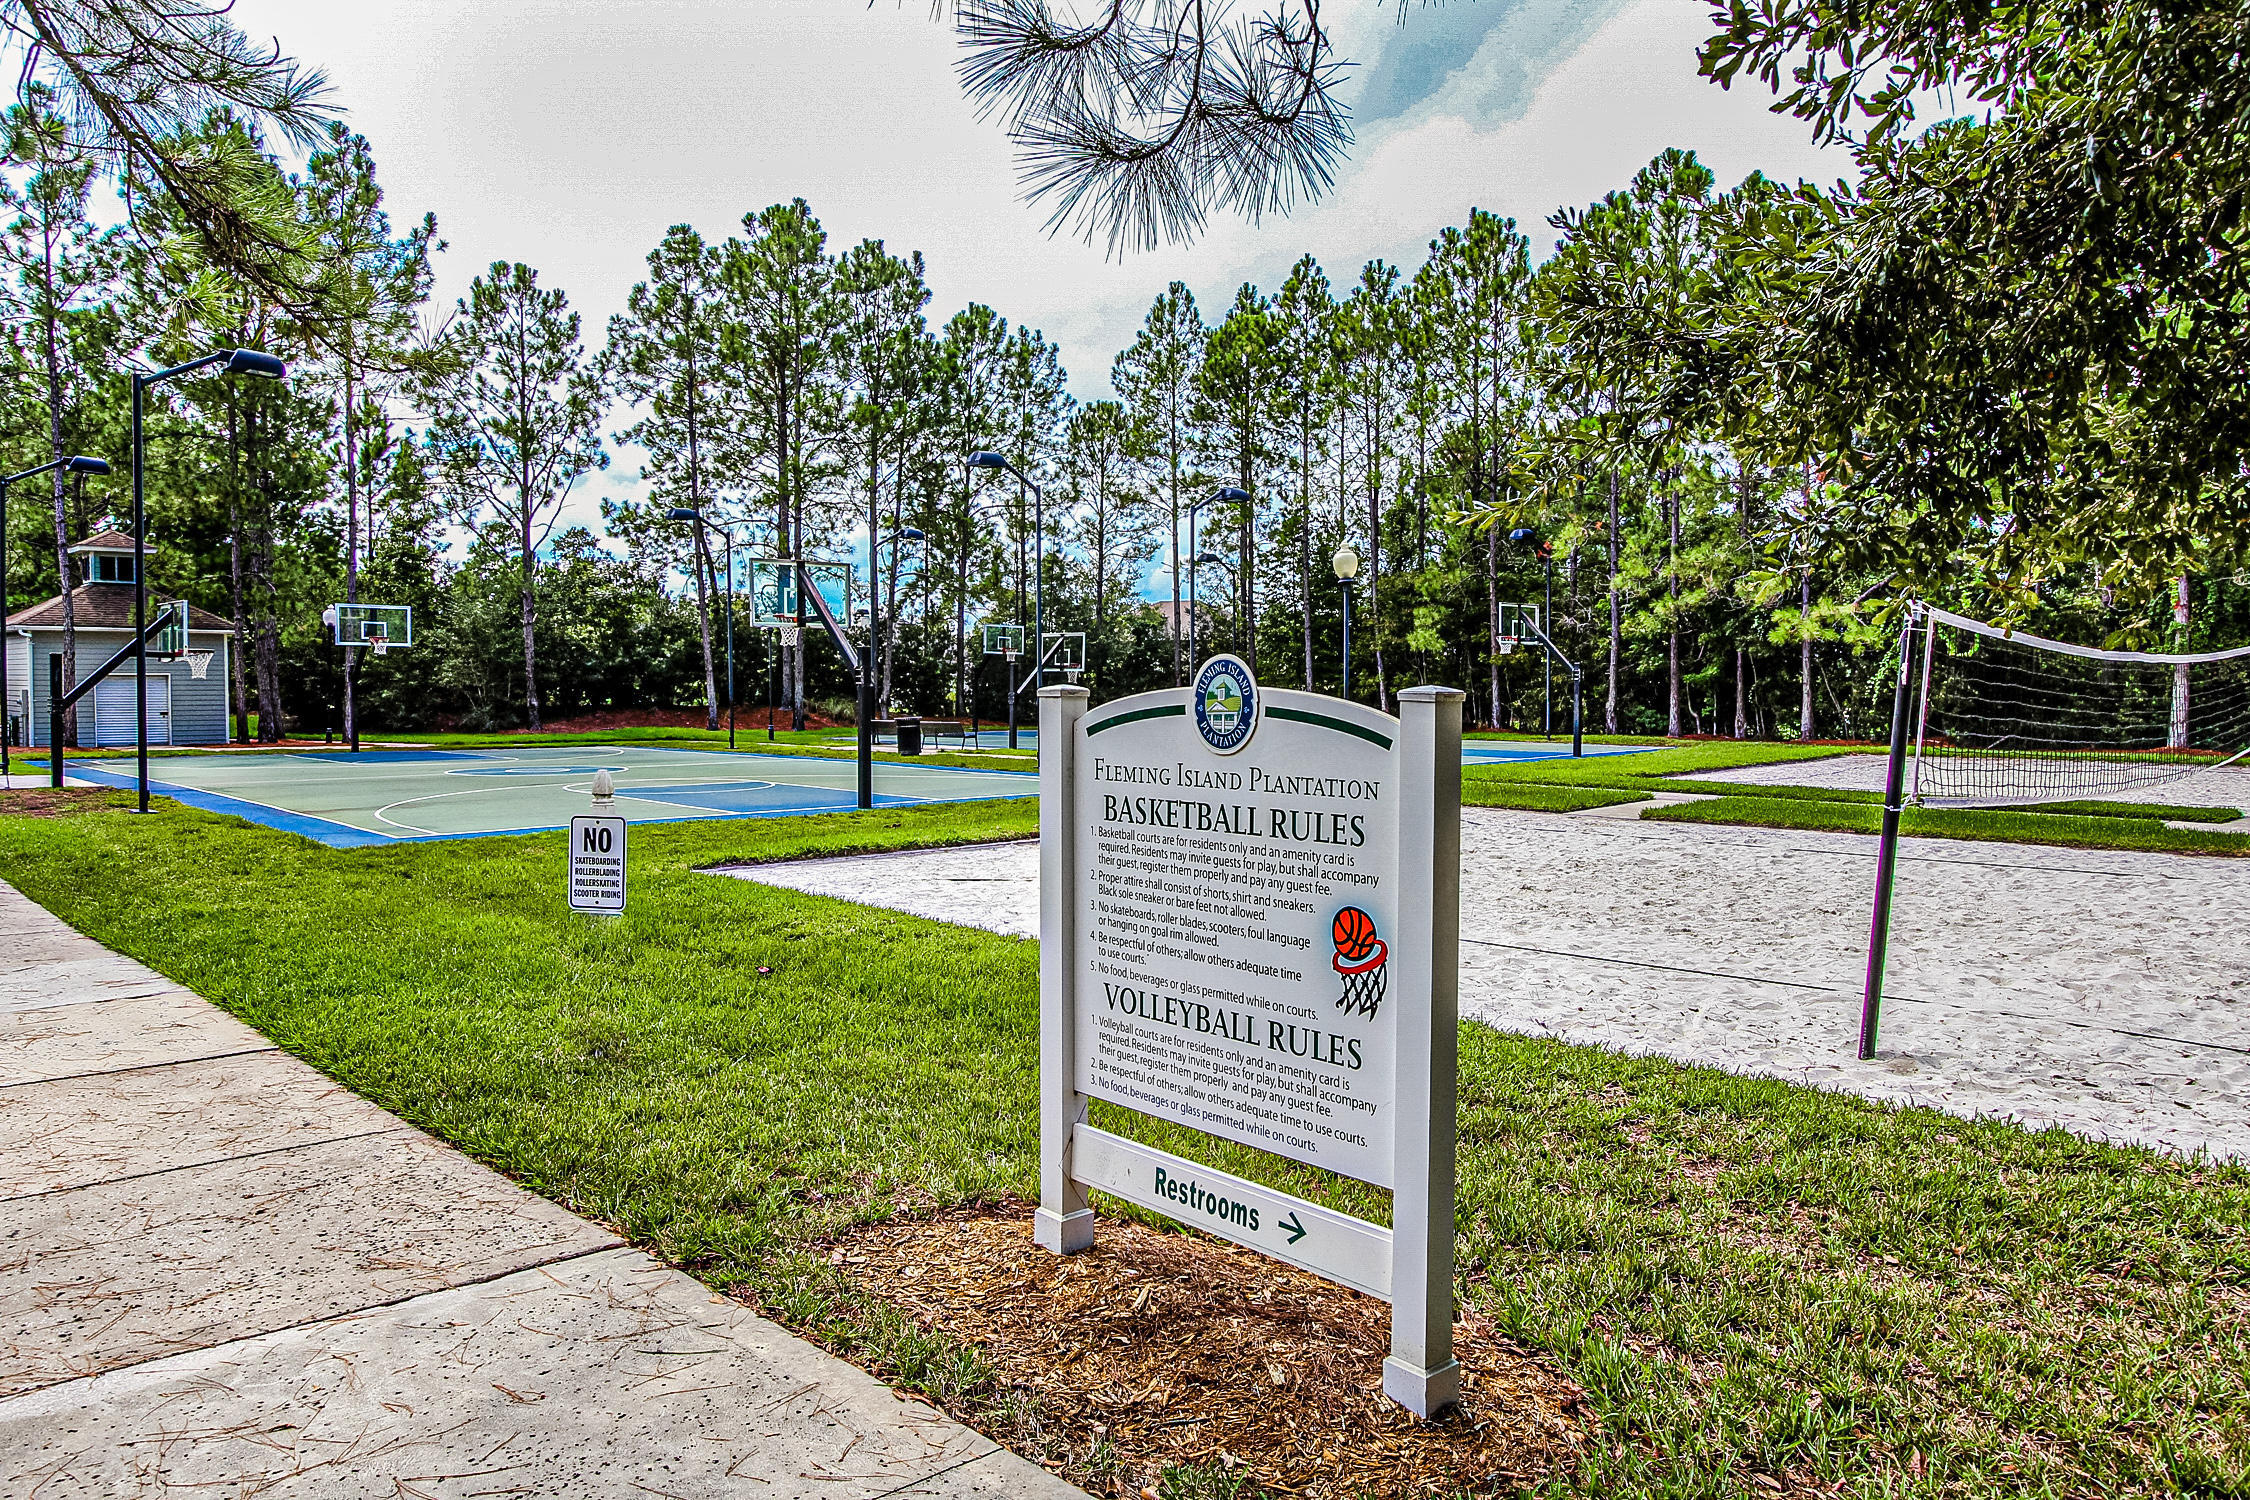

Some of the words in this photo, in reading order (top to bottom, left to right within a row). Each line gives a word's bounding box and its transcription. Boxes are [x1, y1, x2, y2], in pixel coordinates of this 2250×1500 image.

[1198, 661, 1226, 694] FLEMING
[1228, 663, 1250, 696] ISLAND
[1200, 721, 1246, 746] PLANTATION
[1094, 758, 1171, 786] FLEMING
[1176, 762, 1242, 791] ISLAND
[1249, 767, 1380, 801] PLANTATION
[583, 827, 612, 853] NO
[1103, 793, 1262, 836] BASKETBALL
[1268, 807, 1365, 847] RULES
[575, 857, 620, 866] SKATEBOARDING
[1090, 825, 1096, 836] 1.
[1098, 825, 1135, 840] Basketball
[1136, 832, 1160, 844] courts
[1161, 835, 1174, 845] are
[1175, 833, 1188, 847] for
[1188, 836, 1227, 852] residents
[1228, 840, 1248, 856] only
[1249, 843, 1266, 856] and
[1268, 847, 1280, 858] an
[1281, 848, 1321, 865] amenity
[1322, 851, 1344, 865] card
[1346, 853, 1354, 866] is
[1098, 840, 1130, 854] required.
[1131, 843, 1168, 859] Residents
[1169, 850, 1187, 864] may
[1188, 849, 1211, 865] invite
[1212, 856, 1241, 868] guests
[1242, 856, 1255, 870] for
[1256, 858, 1278, 875] play,
[1278, 860, 1295, 875] but
[1296, 862, 1318, 878] shall
[1320, 869, 1379, 888] accompany
[574, 889, 600, 898] SCOOTER
[600, 891, 621, 899] RIDING
[575, 868, 620, 877] ROLLERBLADING
[575, 879, 620, 888] ROLLERSKATING
[1090, 868, 1097, 880] 2.
[1098, 869, 1122, 885] Proper
[1123, 874, 1143, 887] attire
[1144, 876, 1162, 890] shall
[1163, 881, 1191, 895] consist
[1192, 883, 1202, 896] of
[1202, 885, 1231, 902] shorts,
[1231, 889, 1252, 904] shirt
[1253, 893, 1271, 907] and
[1272, 897, 1316, 914] sneakers.
[1097, 852, 1115, 865] their
[1115, 857, 1139, 871] guest,
[1139, 859, 1169, 874] register
[1169, 862, 1191, 876] them
[1193, 868, 1229, 884] properly
[1230, 871, 1247, 884] and
[1249, 875, 1266, 890] pay
[1267, 878, 1284, 892] any
[1285, 880, 1313, 893] guest
[1314, 880, 1332, 896] fee.
[1090, 898, 1096, 911] 3.
[1098, 900, 1109, 913] No
[1109, 902, 1157, 923] skateboards,
[1157, 911, 1178, 925] roller
[1179, 913, 1208, 932] blades,
[1208, 922, 1246, 939] scooters,
[1247, 924, 1264, 940] foul
[1266, 928, 1310, 949] language
[1098, 883, 1117, 897] Black
[1118, 887, 1133, 900] sole
[1134, 891, 1164, 904] sneaker
[1165, 896, 1174, 906] or
[1175, 894, 1194, 910] bare
[1195, 897, 1212, 913] feet
[1213, 904, 1228, 915] not
[1229, 904, 1266, 921] allowed.
[1097, 916, 1106, 925] or
[1107, 914, 1138, 935] hanging
[1138, 924, 1149, 934] on
[1150, 925, 1168, 938] goal
[1169, 927, 1183, 940] rim
[1184, 929, 1219, 947] allowed.
[1089, 929, 1096, 941] 4.
[1098, 930, 1107, 943] Be
[1108, 935, 1145, 950] respectful
[1146, 940, 1155, 952] of
[1155, 943, 1183, 960] others;
[1183, 947, 1206, 963] allow
[1206, 953, 1234, 968] others
[1235, 958, 1278, 977] adequate
[1279, 966, 1302, 982] time
[1097, 945, 1106, 956] to
[1107, 948, 1120, 959] use
[1120, 951, 1146, 965] courts.
[1090, 959, 1096, 971] 5.
[1098, 961, 1109, 974] No
[1109, 963, 1128, 980] food,
[1129, 967, 1168, 988] beverages
[1169, 979, 1179, 989] or
[1179, 979, 1200, 994] glass
[1201, 986, 1244, 1004] permitted
[1245, 994, 1270, 1010] while
[1271, 1001, 1284, 1013] on
[1286, 1004, 1318, 1020] courts.
[1102, 981, 1260, 1046] VOLLEYBALL
[1266, 1019, 1362, 1070] RULES
[1091, 1013, 1097, 1025] 1.
[1098, 1015, 1133, 1034] Volleyball
[1134, 1027, 1158, 1041] courts
[1159, 1033, 1172, 1045] are
[1173, 1034, 1185, 1048] for
[1186, 1040, 1223, 1058] residents
[1225, 1049, 1244, 1065] only
[1245, 1055, 1263, 1068] and
[1264, 1060, 1276, 1072] an
[1278, 1063, 1317, 1084] amenity
[1318, 1074, 1340, 1088] card
[1342, 1076, 1349, 1090] is
[1098, 1031, 1131, 1047] required.
[1131, 1037, 1168, 1058] Residents
[1169, 1050, 1186, 1065] may
[1187, 1052, 1211, 1069] invite
[1212, 1061, 1241, 1077] guests
[1241, 1066, 1255, 1081] for
[1256, 1071, 1276, 1088] play,
[1277, 1075, 1294, 1092] but
[1295, 1080, 1317, 1097] shall
[1318, 1089, 1377, 1115] accompany
[1090, 1056, 1097, 1068] 2.
[1098, 1058, 1108, 1072] Be
[1109, 1064, 1145, 1083] respectful
[1146, 1073, 1155, 1085] of
[1155, 1077, 1183, 1095] others;
[1183, 1084, 1206, 1100] allow
[1207, 1092, 1234, 1109] others
[1235, 1100, 1278, 1121] adequate
[1279, 1111, 1301, 1128] time
[1302, 1118, 1313, 1131] to
[1315, 1123, 1332, 1137] use
[1333, 1129, 1367, 1147] courts.
[1098, 1043, 1115, 1056] their
[1116, 1049, 1139, 1065] guest,
[1139, 1056, 1169, 1072] register
[1169, 1062, 1191, 1078] them
[1192, 1071, 1228, 1091] properly
[1231, 1081, 1248, 1094] and
[1250, 1086, 1267, 1102] pay
[1268, 1087, 1286, 1107] any
[1287, 1096, 1314, 1112] guest
[1315, 1100, 1333, 1117] fee.
[1090, 1073, 1097, 1085] 3.
[1098, 1075, 1109, 1089] No
[1110, 1079, 1129, 1096] food,
[1129, 1084, 1169, 1108] beverages
[1170, 1100, 1179, 1110] or
[1180, 1101, 1200, 1117] glass
[1201, 1110, 1244, 1130] permitted
[1245, 1121, 1270, 1138] while
[1271, 1130, 1284, 1142] on
[1286, 1135, 1318, 1153] courts.
[1154, 1167, 1260, 1232] Restrooms
